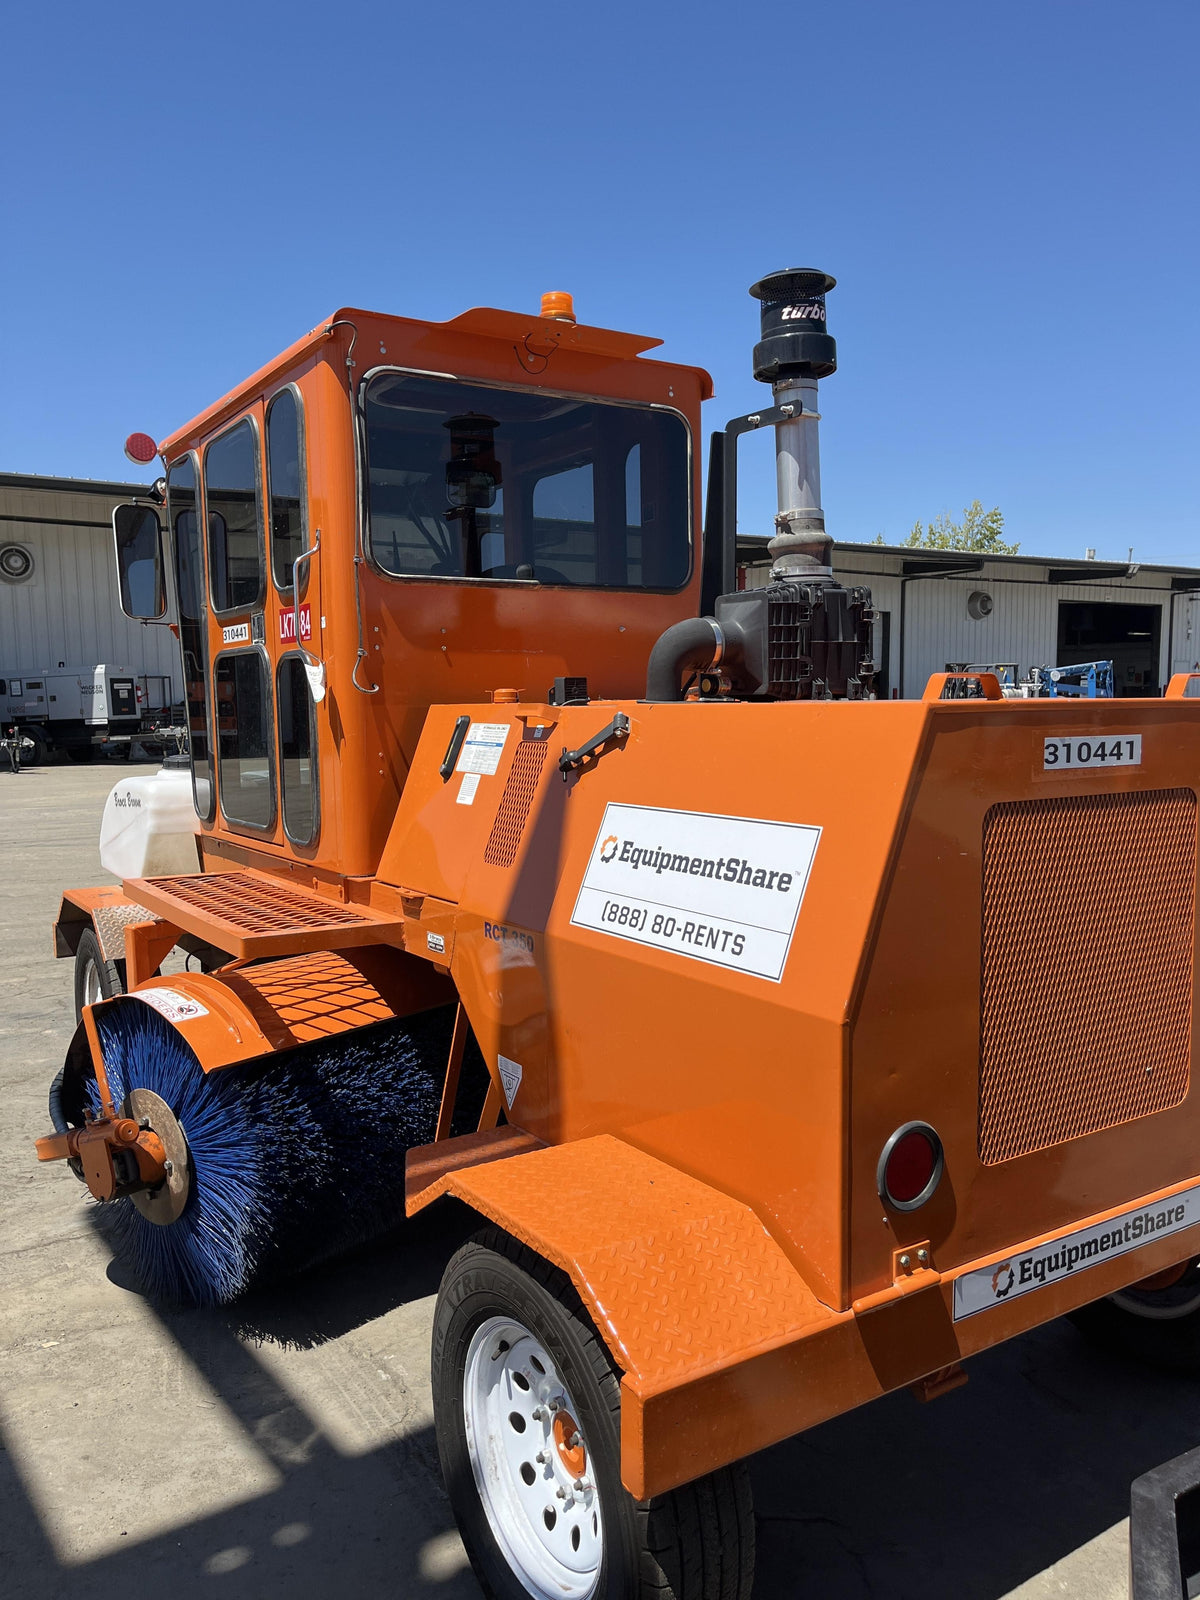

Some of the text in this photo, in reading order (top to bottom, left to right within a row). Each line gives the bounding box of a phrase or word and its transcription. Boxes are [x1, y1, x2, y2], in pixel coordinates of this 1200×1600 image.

[781, 303, 826, 321] turbo
[223, 626, 247, 640] 310441
[279, 609, 311, 638] LK784
[1044, 740, 1135, 764] 310441
[618, 840, 792, 893] EquipmentShare
[484, 921, 508, 945] RCT
[601, 900, 746, 956] (888) 80-RENTS
[1018, 1203, 1185, 1285] EquipmentShare
